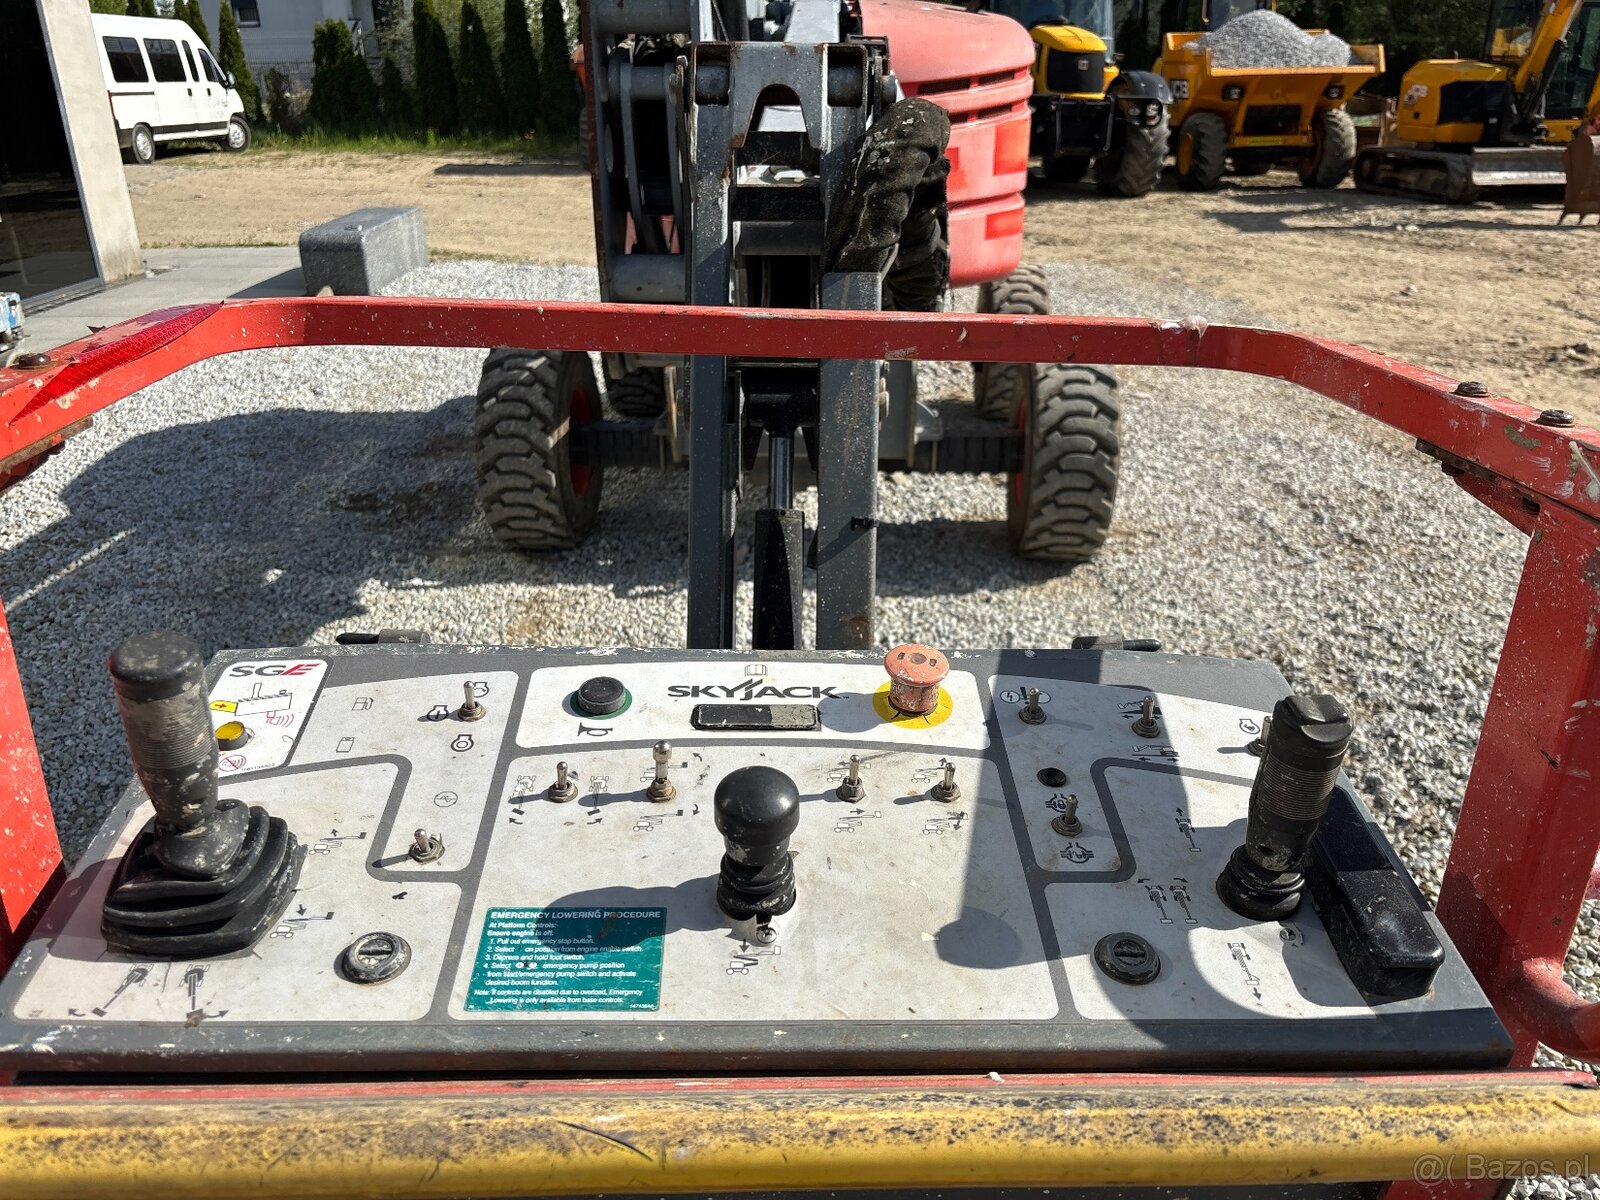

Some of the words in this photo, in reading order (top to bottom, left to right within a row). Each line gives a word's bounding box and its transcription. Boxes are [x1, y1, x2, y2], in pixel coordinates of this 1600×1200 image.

[228, 663, 321, 677] SGE
[667, 678, 843, 701] SKYJACK
[490, 911, 550, 919] EMERGENCY
[551, 911, 601, 919] LOWERING
[608, 989, 643, 997] Emergency
[525, 997, 539, 1005] only
